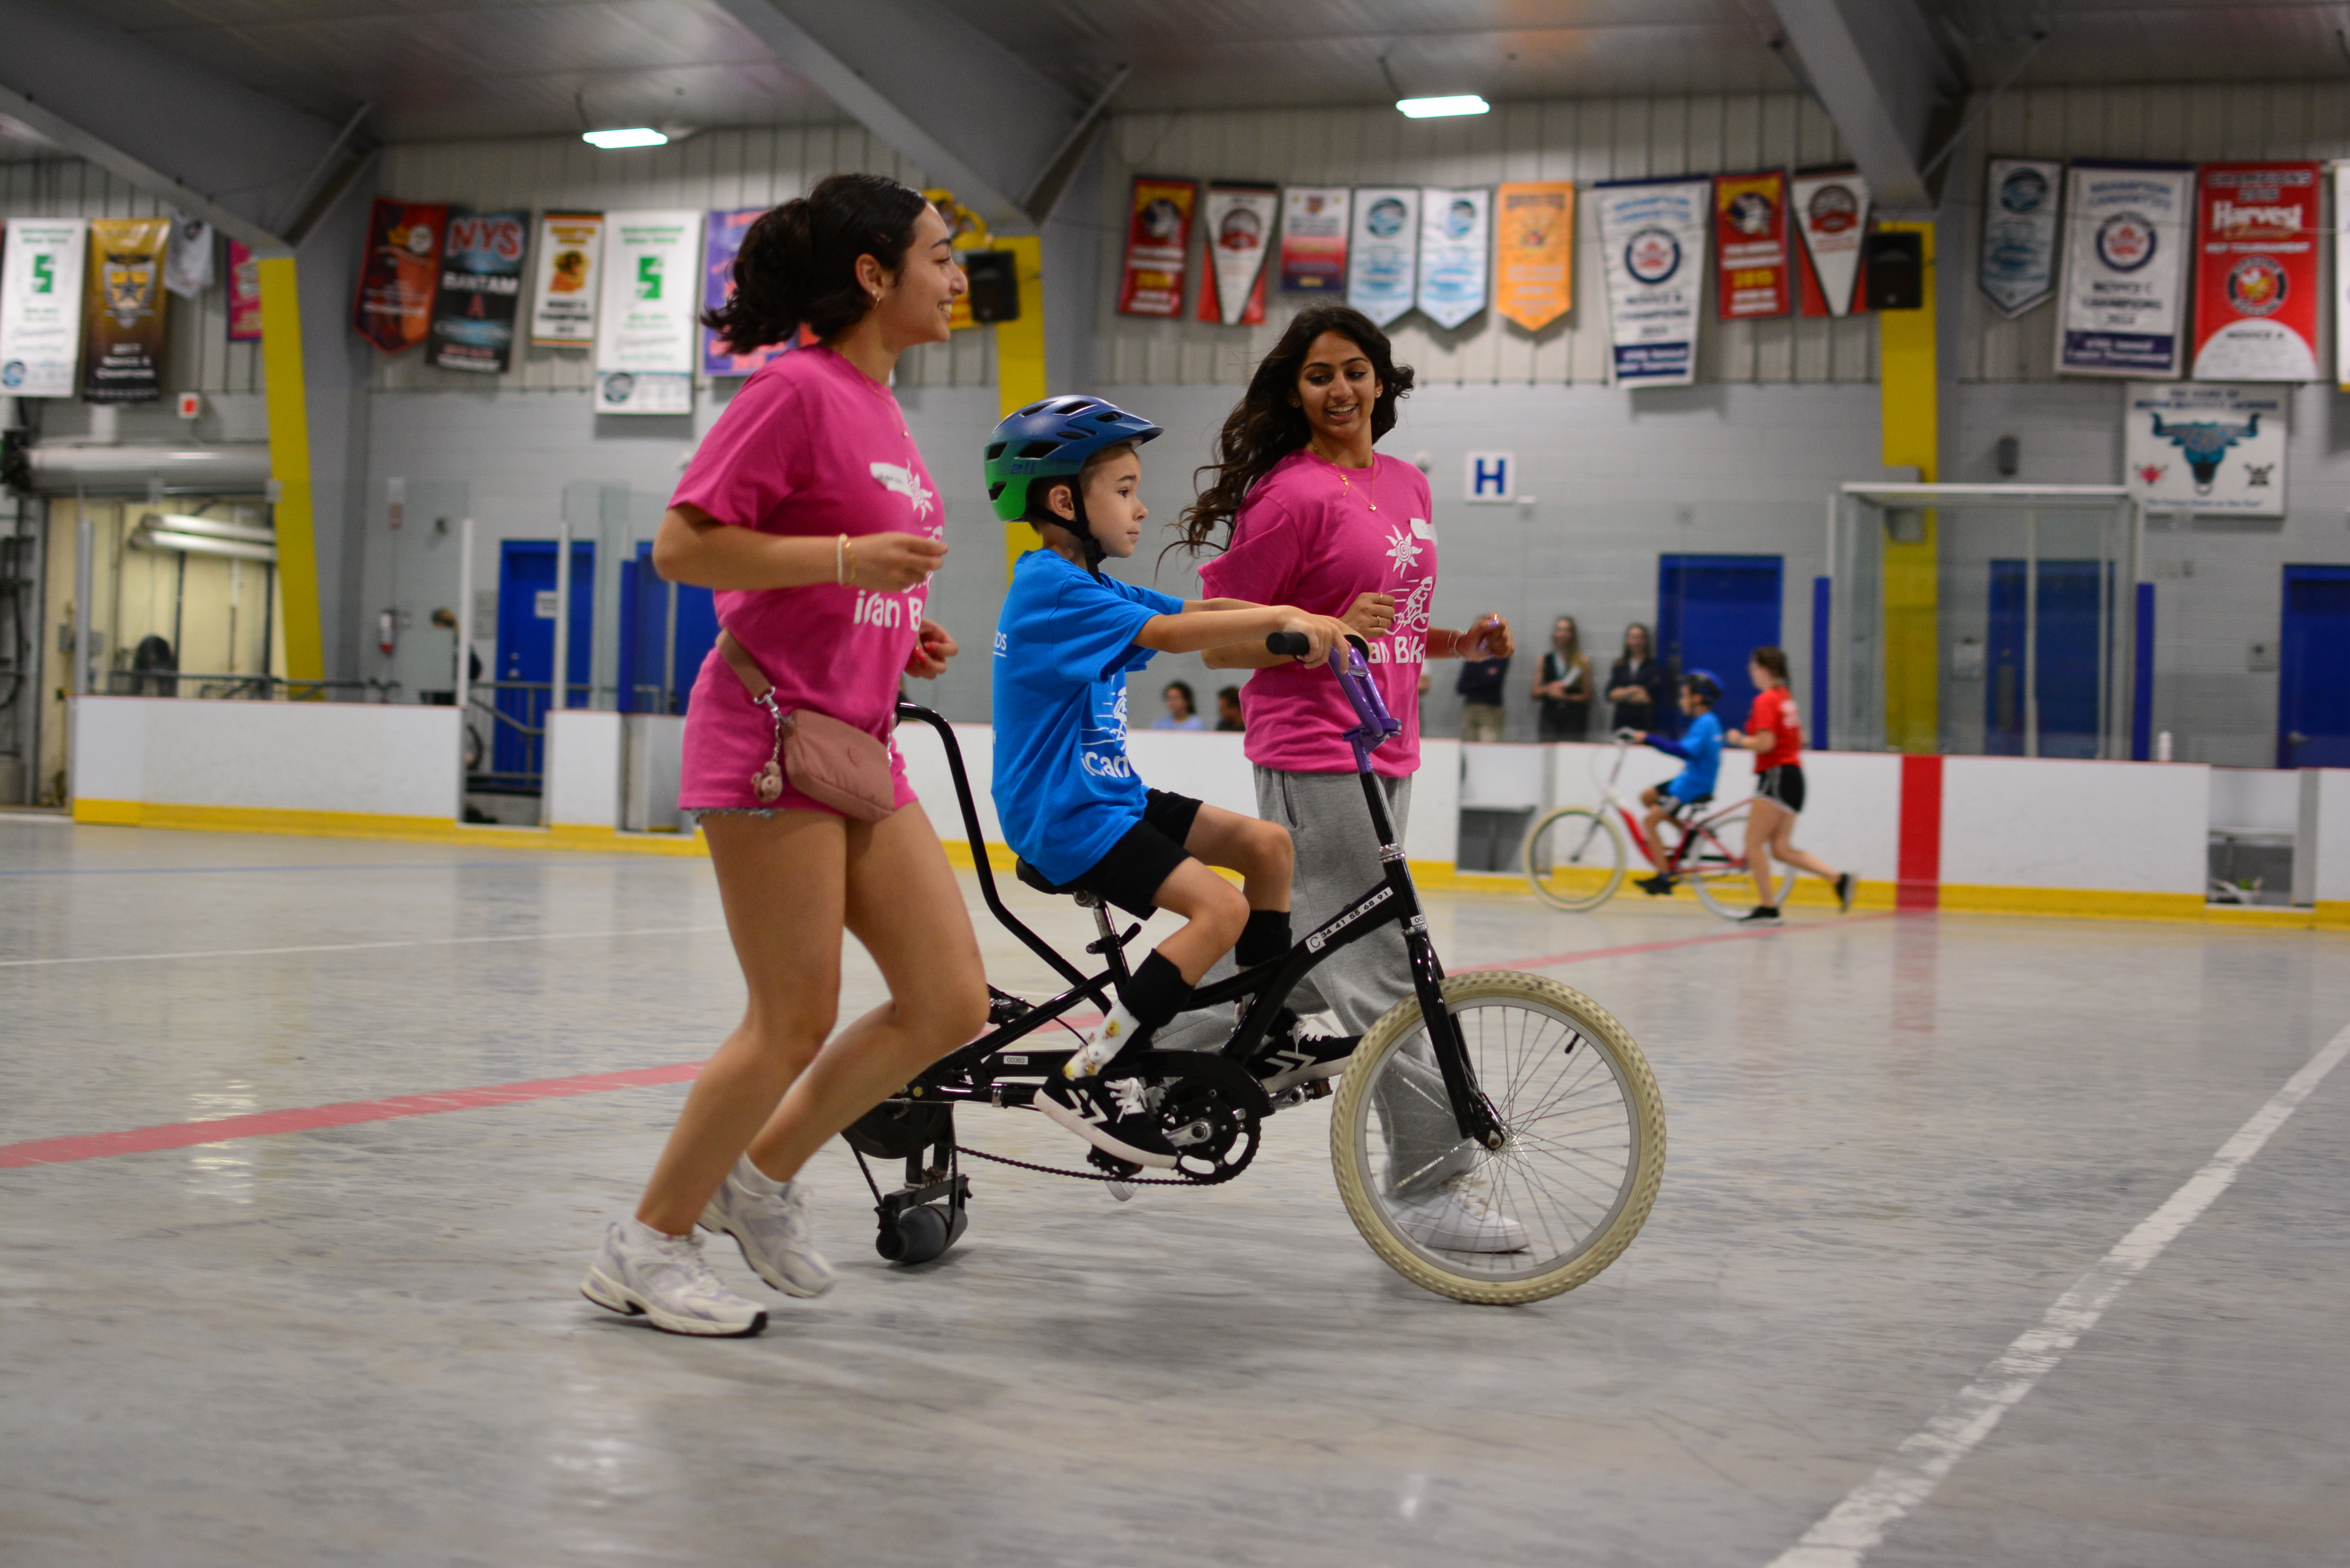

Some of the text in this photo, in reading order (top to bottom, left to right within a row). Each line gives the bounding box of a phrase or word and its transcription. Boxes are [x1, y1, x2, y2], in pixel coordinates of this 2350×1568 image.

[2211, 200, 2303, 233] Harvest
[444, 217, 523, 260] NYS
[442, 272, 519, 294] BANTAM
[467, 294, 485, 318] A
[1475, 458, 1506, 494] H
[1395, 636, 1425, 664] Bik
[1320, 891, 1389, 939] 34 41 55 68 91
[1310, 936, 1321, 949] C
